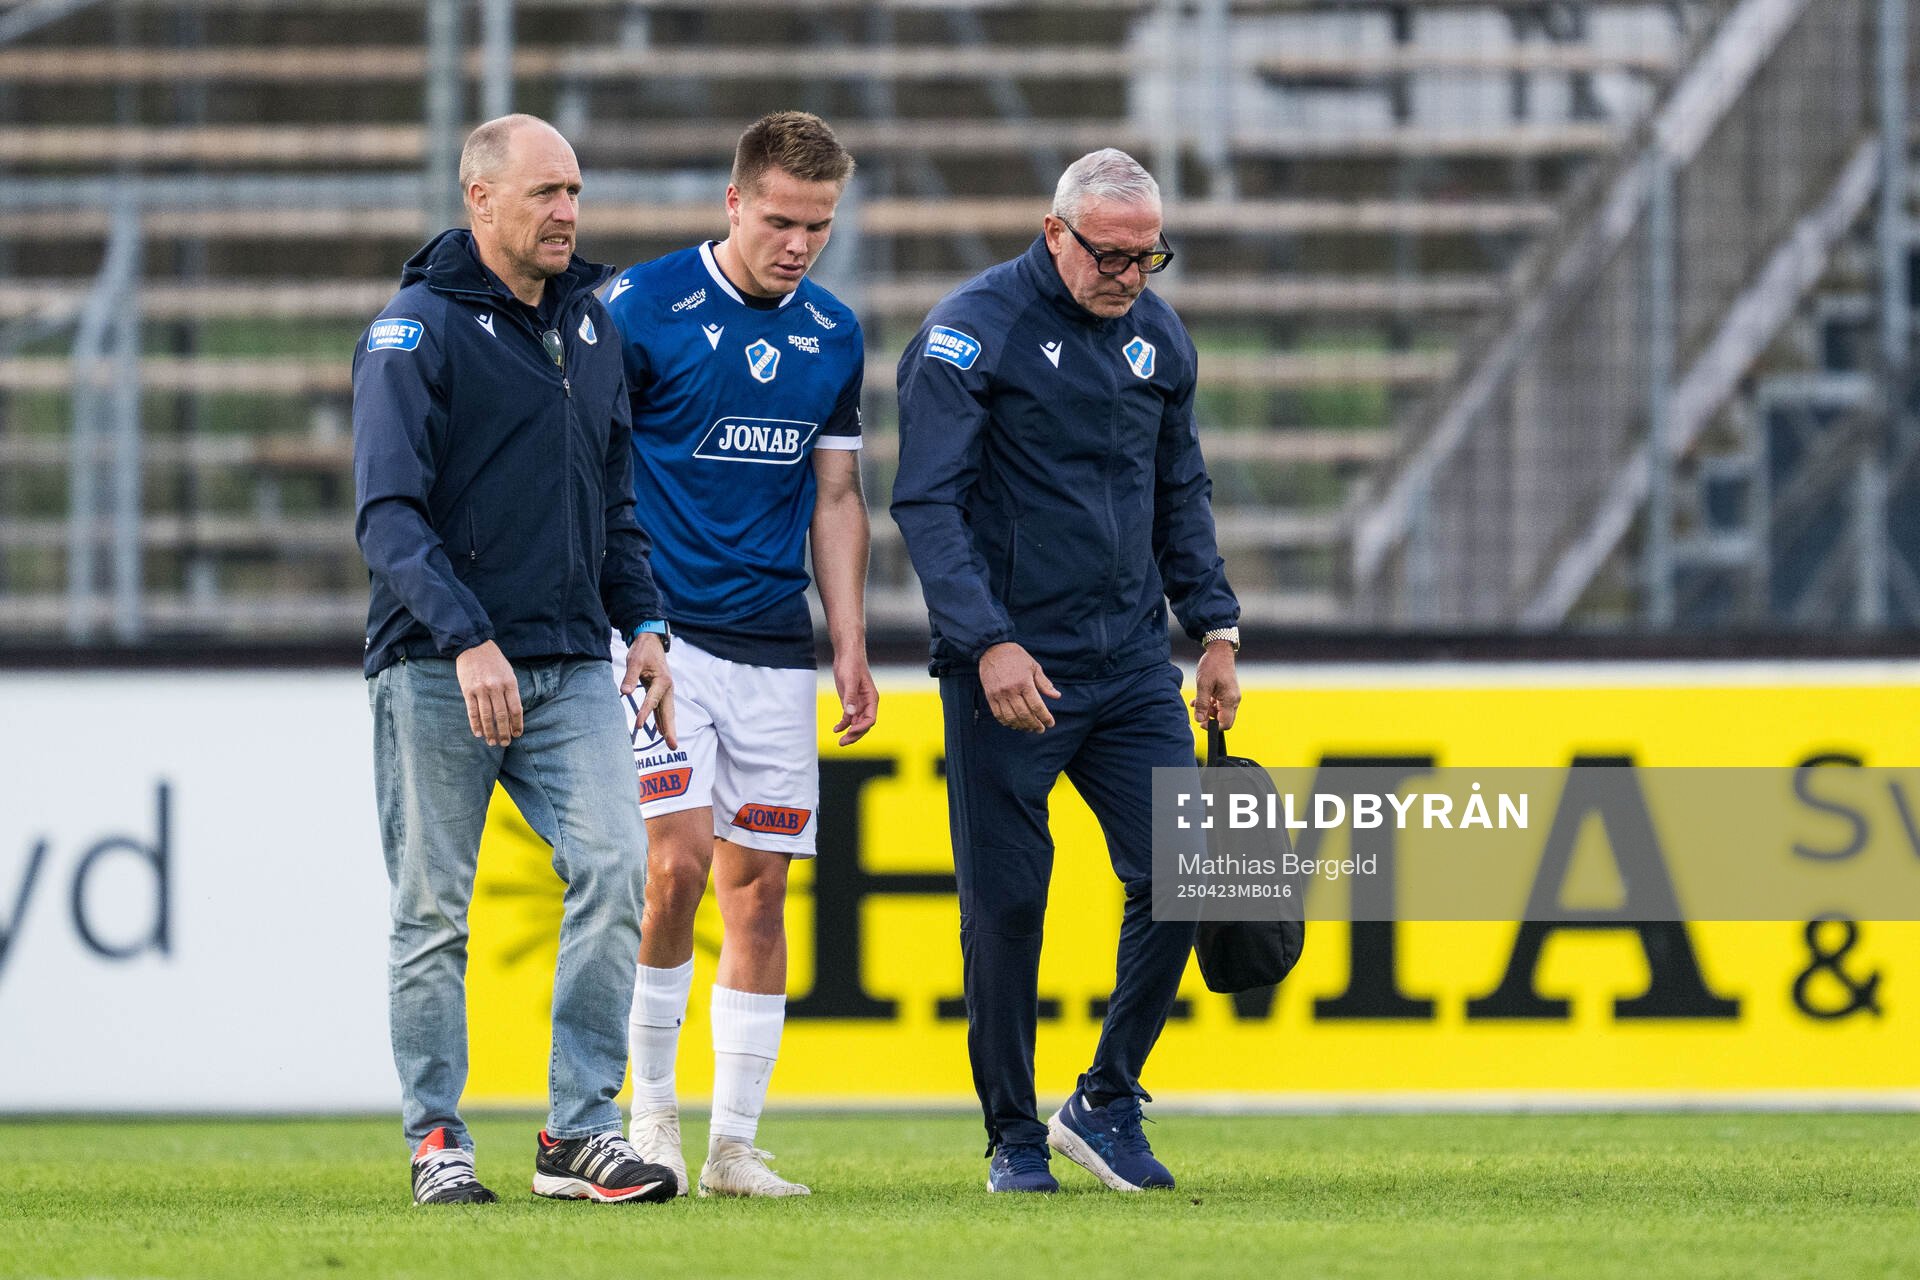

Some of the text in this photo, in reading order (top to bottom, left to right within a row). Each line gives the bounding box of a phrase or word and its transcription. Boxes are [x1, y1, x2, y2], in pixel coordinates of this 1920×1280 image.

[372, 324, 418, 338] UNIBET
[788, 335, 819, 347] sport
[929, 331, 976, 357] UNIBET
[718, 424, 799, 454] JONAB
[743, 808, 799, 830] JONAB
[1793, 912, 1881, 1019] &
